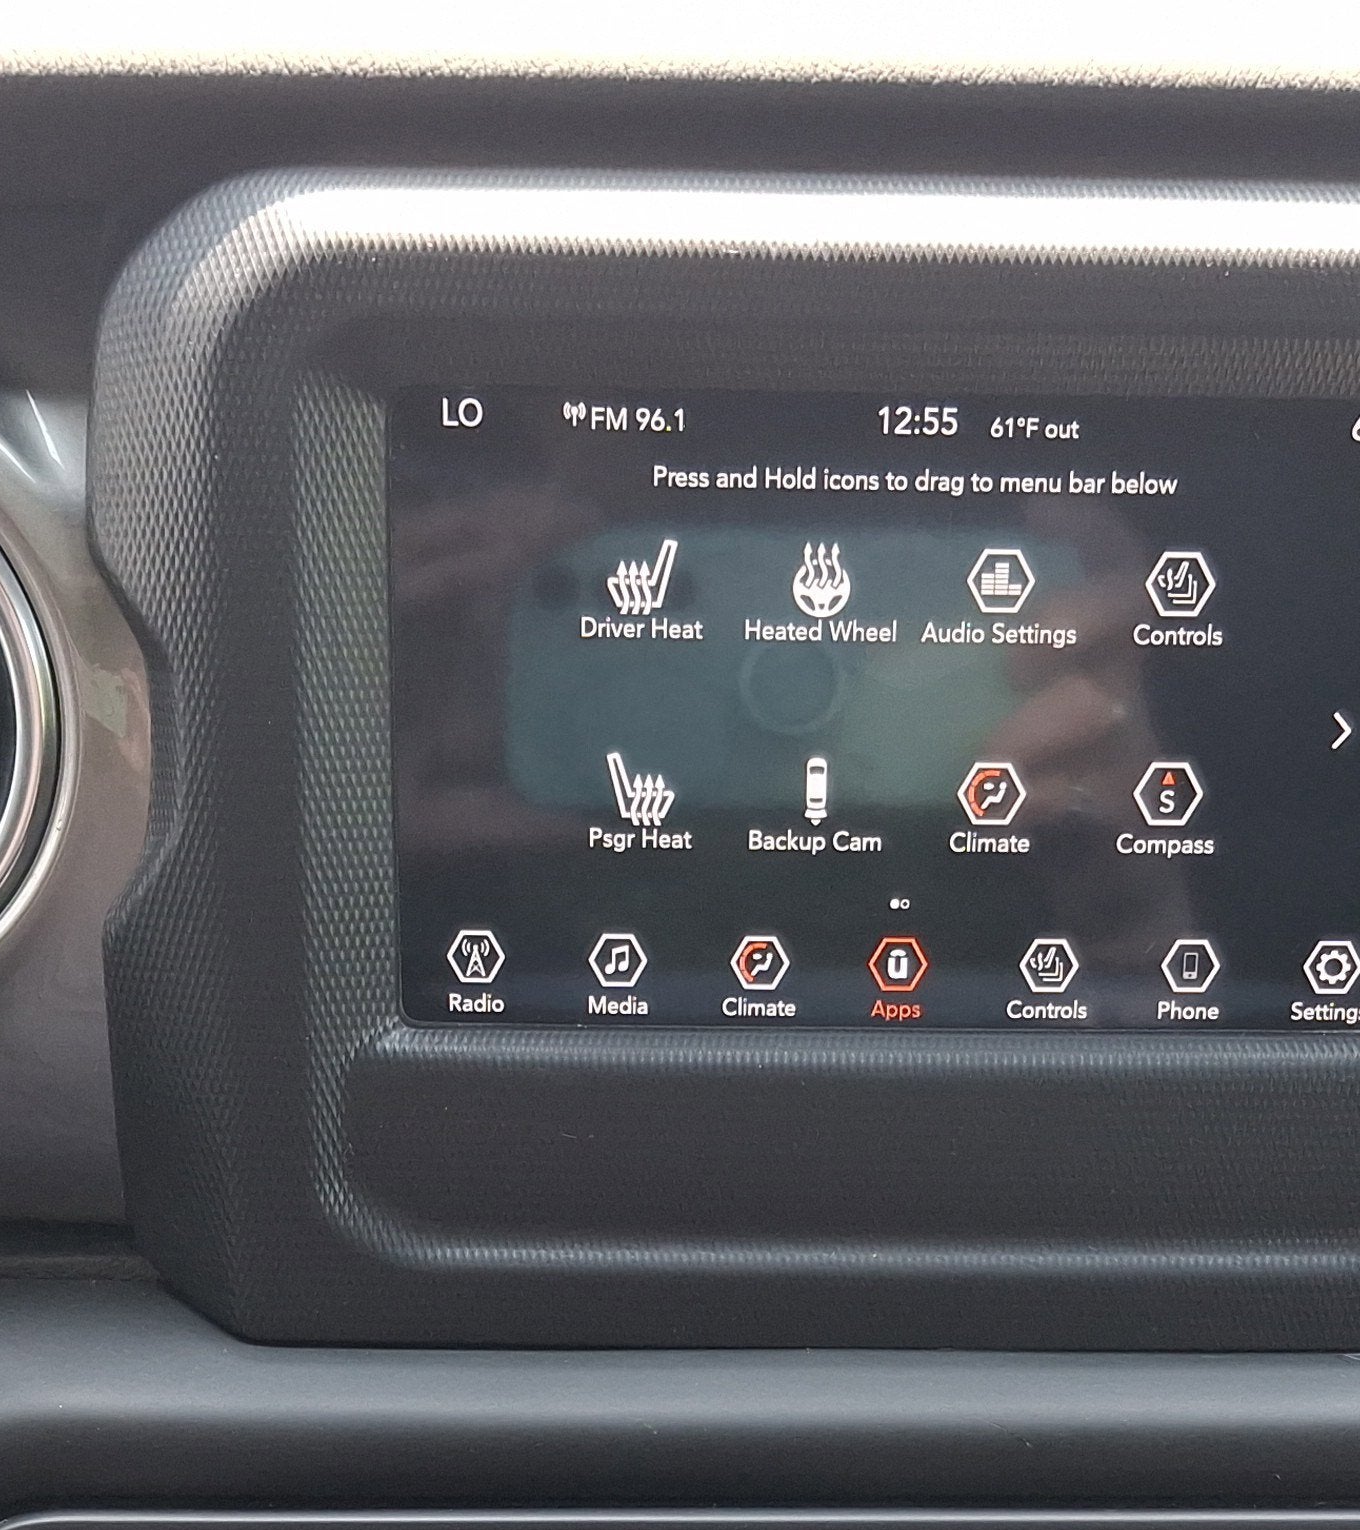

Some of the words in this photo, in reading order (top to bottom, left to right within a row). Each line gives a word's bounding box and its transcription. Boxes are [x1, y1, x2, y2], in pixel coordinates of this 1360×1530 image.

[441, 397, 484, 428] LO
[590, 406, 628, 432] FM
[634, 407, 686, 433] 96.1
[877, 405, 959, 437] 12:55
[989, 416, 1040, 439] 61°F
[1044, 418, 1080, 440] out
[652, 465, 710, 489] Press
[714, 466, 758, 490] and
[764, 466, 817, 491] Hold
[822, 468, 880, 492] icons
[885, 470, 909, 493] to
[914, 470, 965, 497] drag
[970, 472, 994, 494] to
[998, 474, 1062, 495] menu
[1068, 471, 1106, 495] bar
[1110, 471, 1178, 496] below
[579, 615, 645, 640] Driver
[650, 616, 704, 641] Heat
[744, 618, 823, 643] Heated
[828, 618, 898, 644] Wheel
[920, 621, 985, 646] Audio
[990, 621, 1077, 649] Settings
[1132, 623, 1224, 647] Controls
[588, 827, 636, 853] Psgr
[640, 827, 693, 851] Heat
[747, 829, 827, 855] Backup
[831, 830, 883, 853] Cam
[948, 832, 1031, 855] Climate
[1115, 833, 1215, 858] Compass
[448, 992, 505, 1014] Radio
[587, 995, 649, 1017] Media
[721, 996, 797, 1019] Climate
[870, 999, 922, 1021] Apps
[1005, 1000, 1088, 1021] Controls
[1156, 1000, 1220, 1022] Phone
